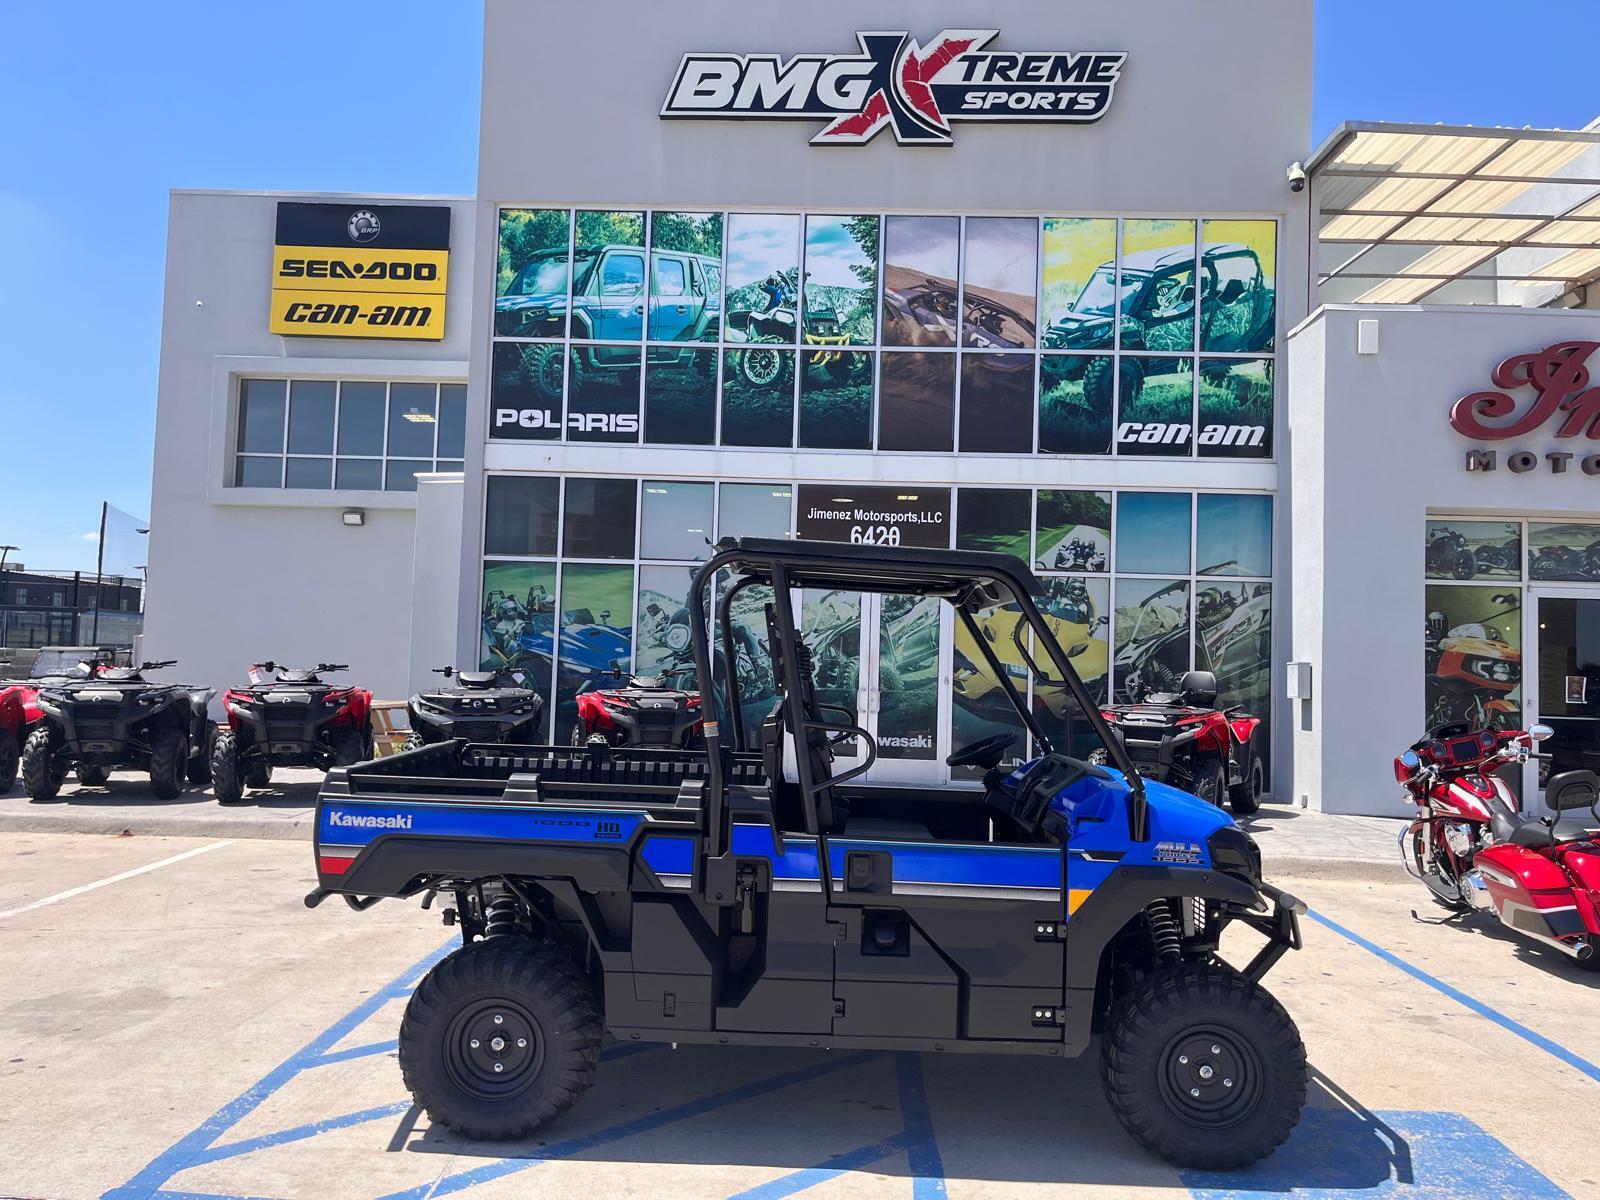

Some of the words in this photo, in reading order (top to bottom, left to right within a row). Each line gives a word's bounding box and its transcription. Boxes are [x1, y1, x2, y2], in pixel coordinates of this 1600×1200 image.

[670, 59, 879, 109] BMG
[961, 91, 1101, 111] SPORTS
[284, 302, 432, 327] can-am
[496, 408, 639, 433] POLARIS
[807, 507, 851, 521] Jimenez
[850, 525, 901, 547] 6420
[329, 811, 413, 830] Kawasaki
[597, 822, 620, 833] HD
